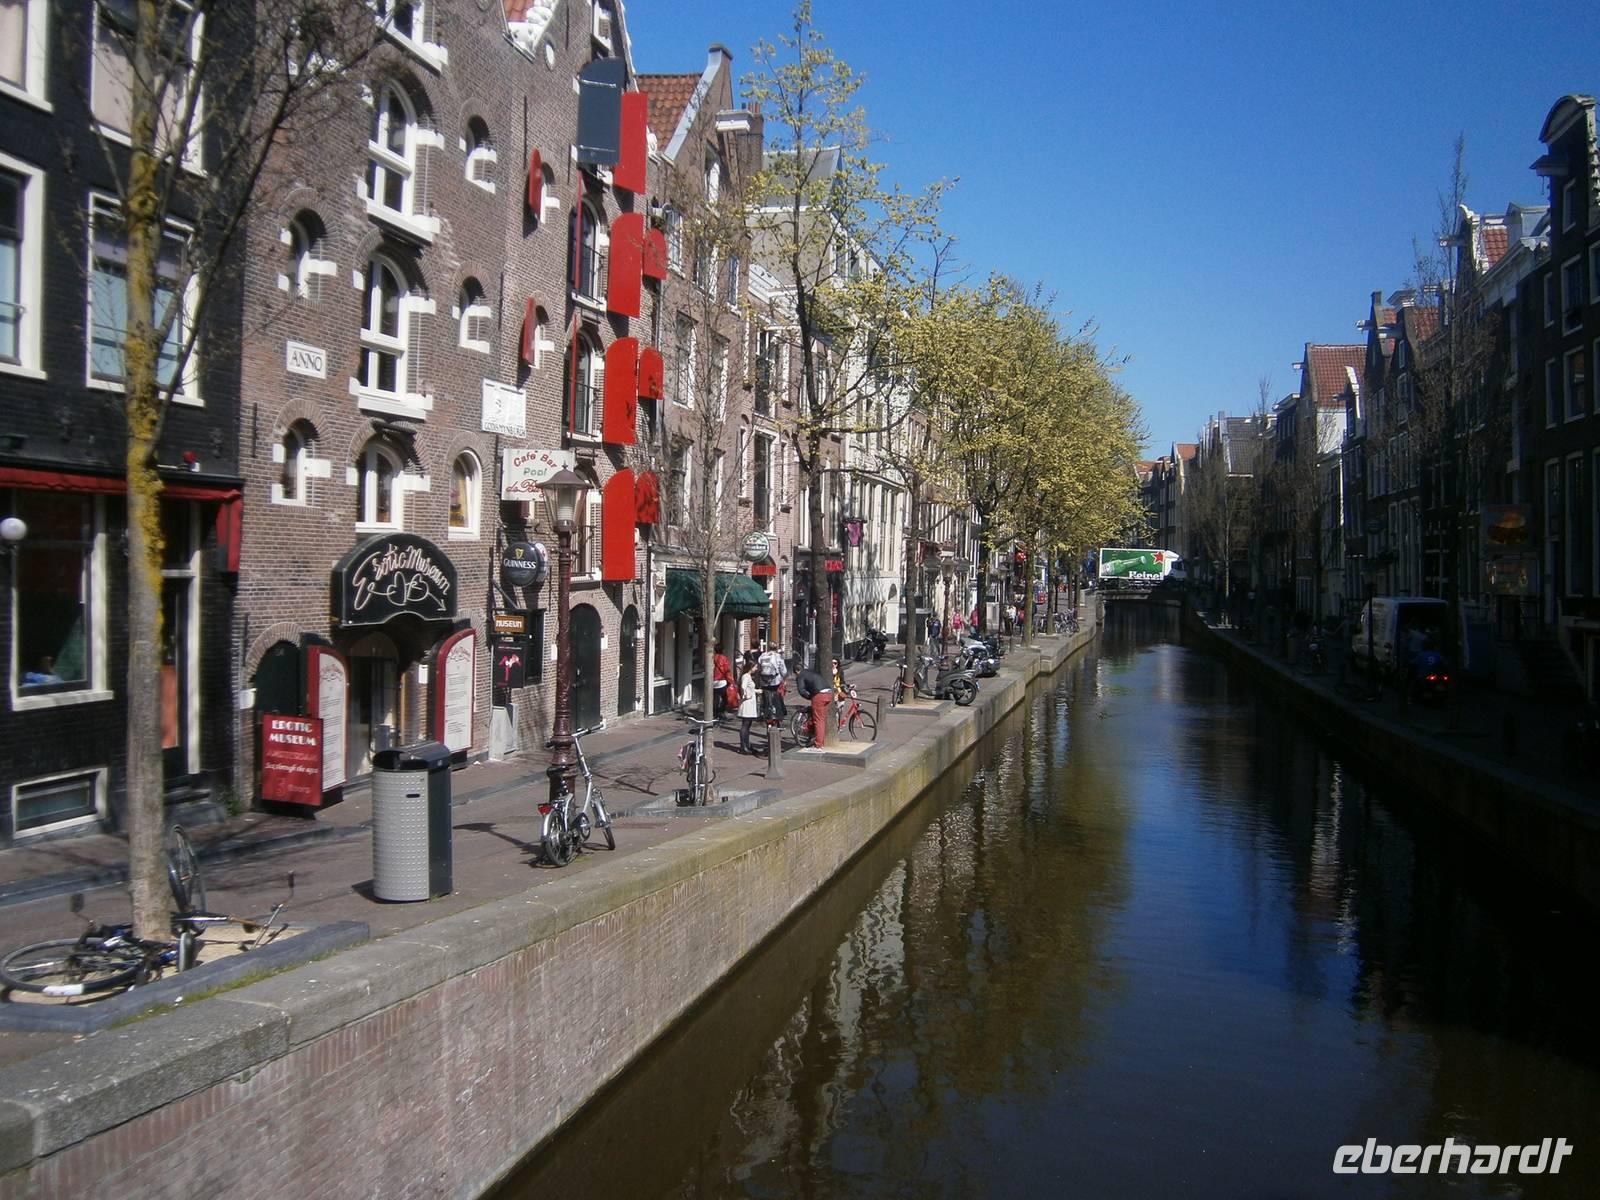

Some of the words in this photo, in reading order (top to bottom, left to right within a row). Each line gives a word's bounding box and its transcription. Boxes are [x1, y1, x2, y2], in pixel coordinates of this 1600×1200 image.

[291, 350, 323, 372] ANNO
[540, 453, 558, 469] Bar
[523, 467, 548, 477] Pool
[503, 557, 537, 570] GUINNESS
[352, 543, 407, 611] Erotic
[405, 545, 451, 596] Museum
[271, 720, 313, 733] EROTIC
[269, 733, 317, 746] MUSEUM
